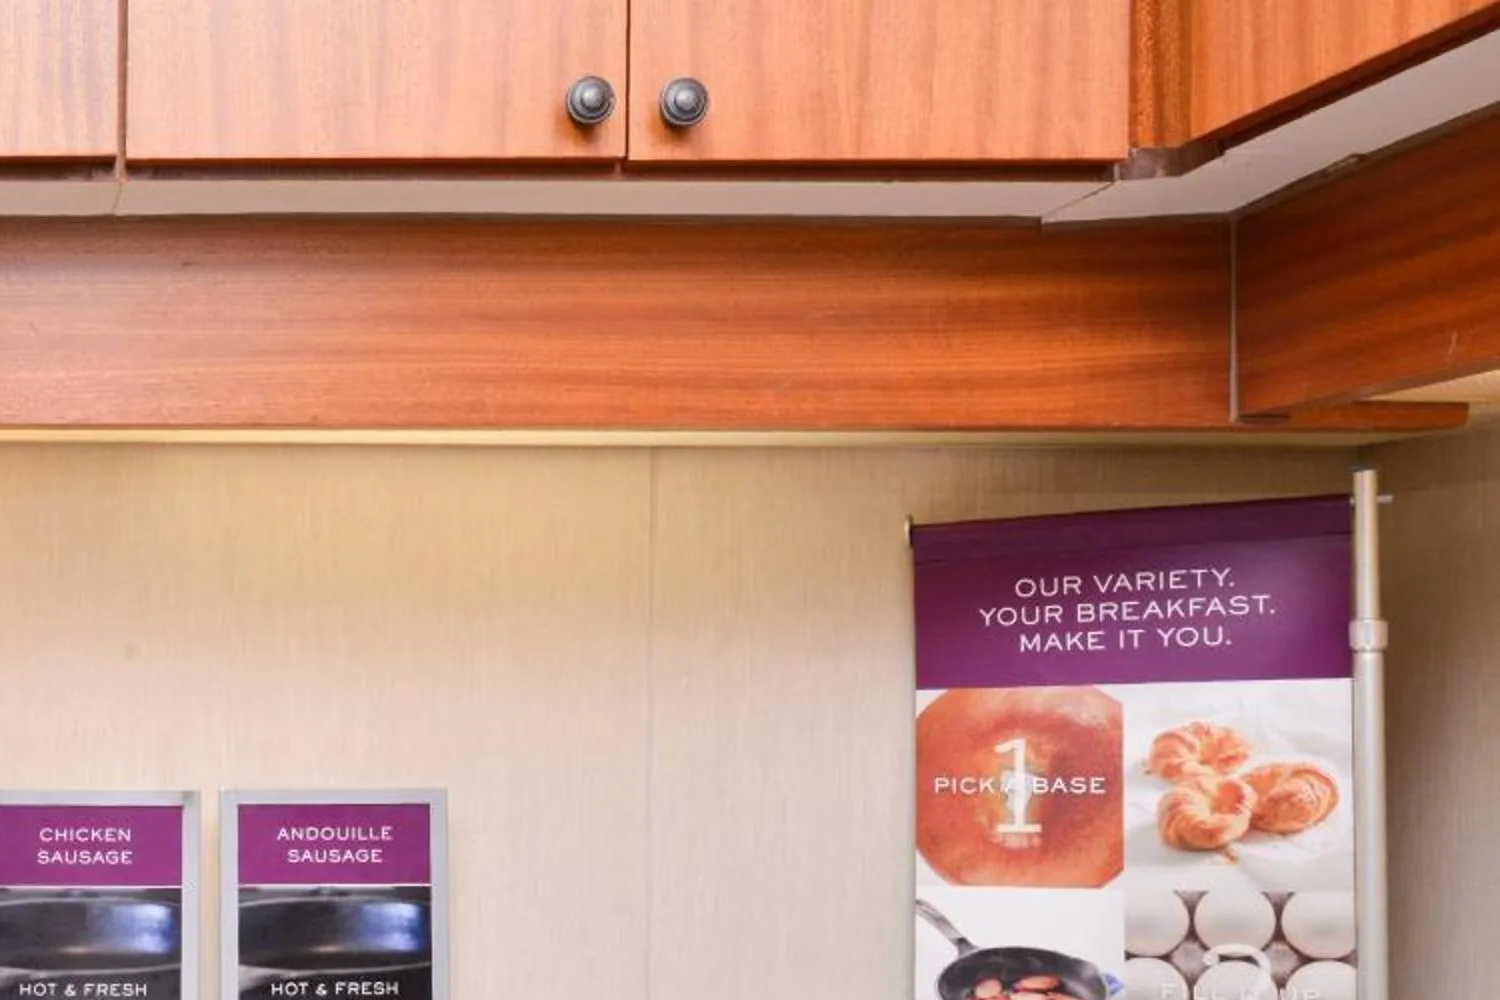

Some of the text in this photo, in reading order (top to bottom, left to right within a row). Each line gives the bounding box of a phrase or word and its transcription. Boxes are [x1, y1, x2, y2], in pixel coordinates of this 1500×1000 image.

[1014, 567, 1235, 598] OUR VARIETY.
[979, 594, 1275, 628] YOUR BREAKFAST.
[1019, 626, 1232, 653] MAKE IT YOU.
[934, 777, 995, 794] PICK
[1032, 777, 1106, 794] BASE
[995, 738, 1042, 833] 1
[39, 827, 131, 843] CHICKEN
[276, 825, 393, 841] ANDOUILLE
[36, 849, 133, 865] SAUSAGE
[287, 849, 383, 864] SAUSAGE
[19, 983, 148, 997] HOT & FRESH
[271, 981, 399, 996] HOT & FRESH
